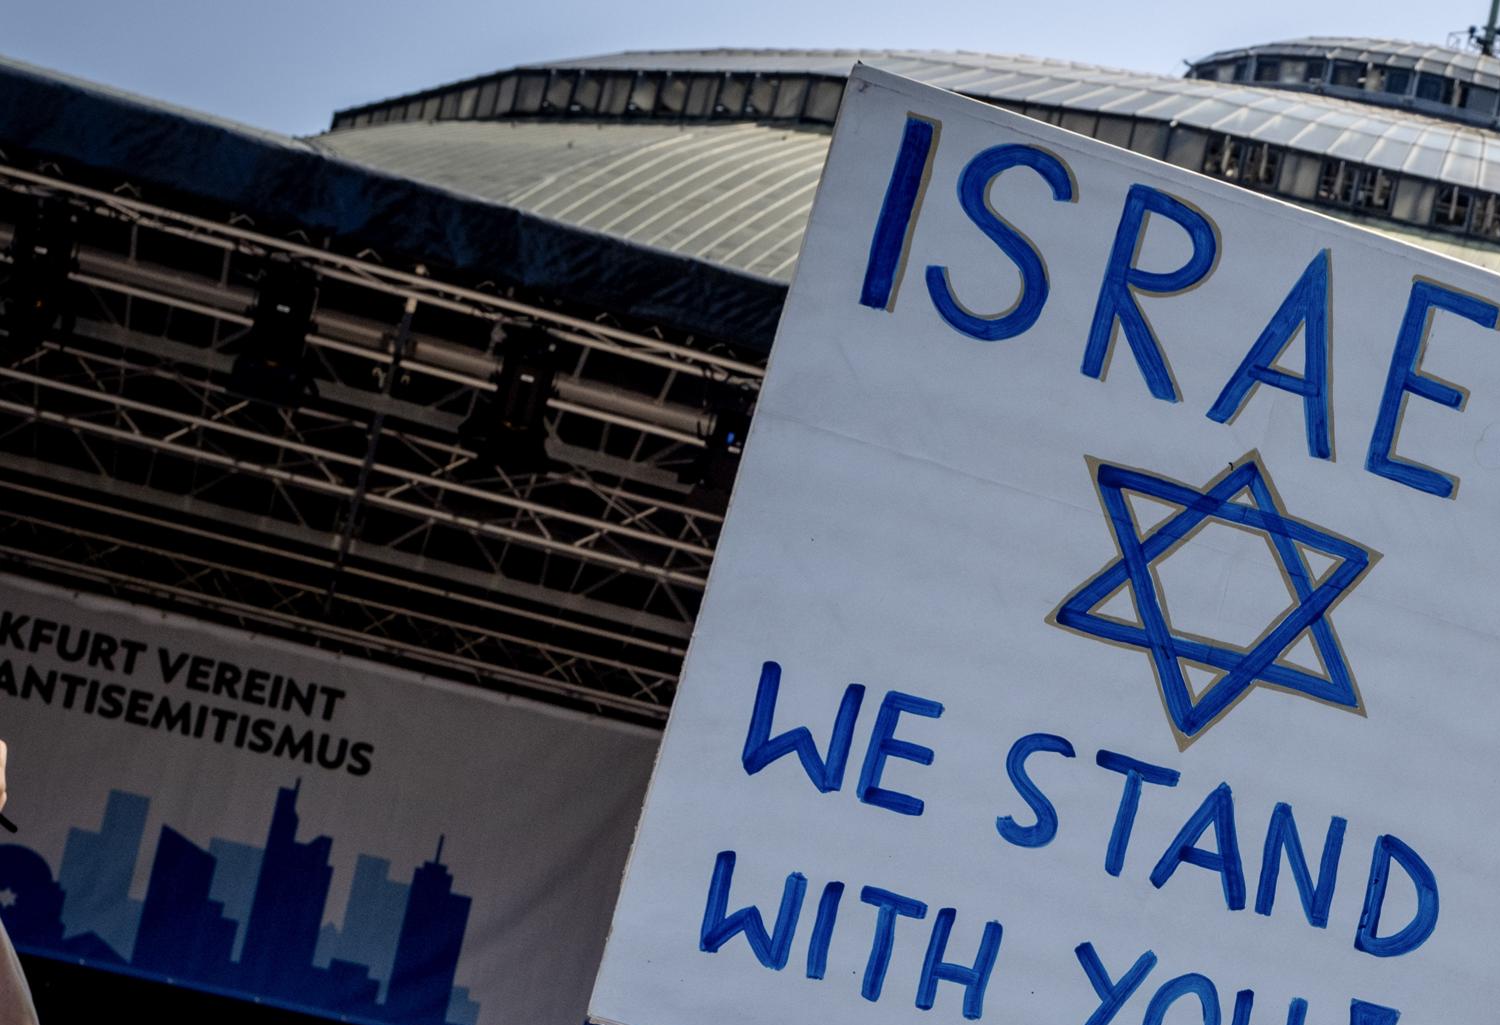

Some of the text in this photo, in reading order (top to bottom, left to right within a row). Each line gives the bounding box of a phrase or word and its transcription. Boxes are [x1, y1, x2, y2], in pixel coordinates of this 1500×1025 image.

[0, 659, 374, 776] ANTISEMITISMUS
[158, 647, 346, 721] VEREINT
[741, 660, 1440, 958] WE STAND
[698, 850, 1004, 1021] WITH
